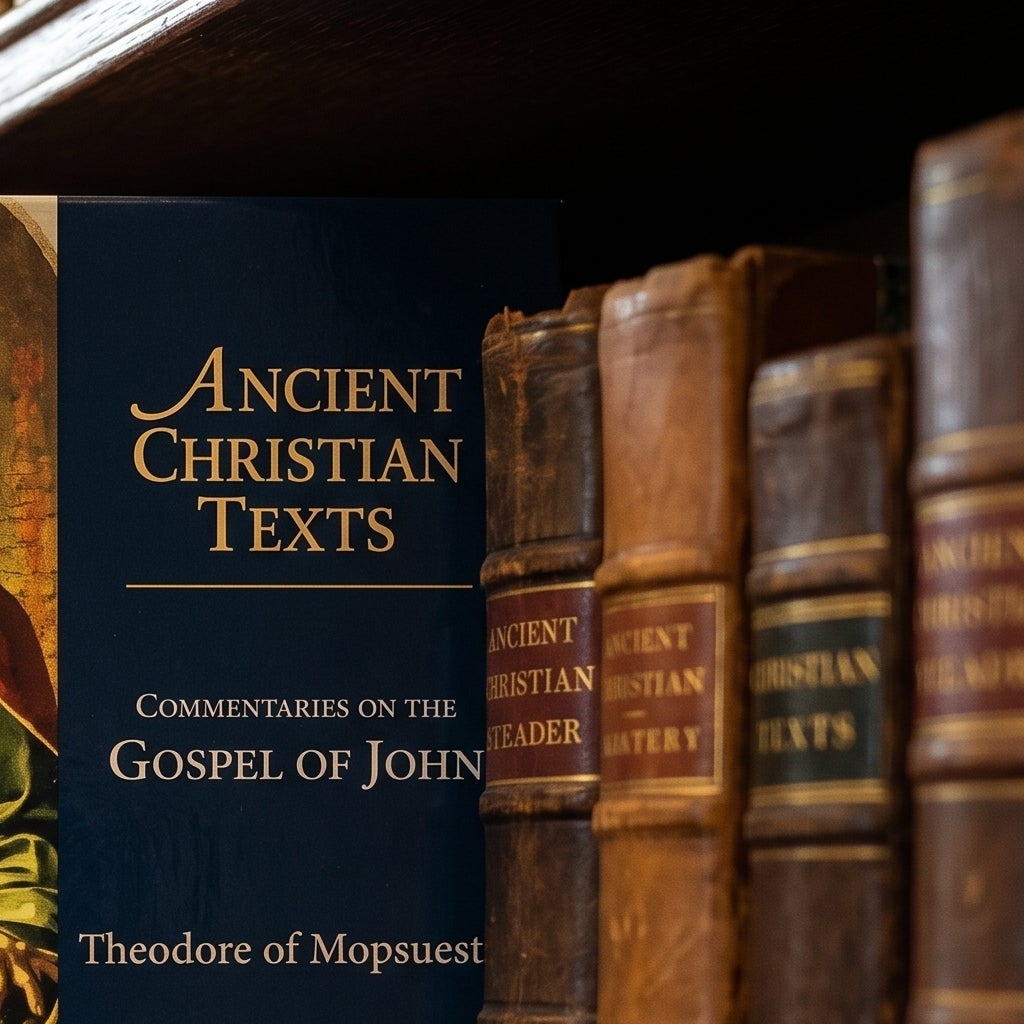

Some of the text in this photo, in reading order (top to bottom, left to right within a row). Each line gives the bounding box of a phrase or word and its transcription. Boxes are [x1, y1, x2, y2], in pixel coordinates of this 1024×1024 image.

[130, 346, 462, 421] ANCIENT
[133, 426, 463, 483] CHRISTIAN
[197, 495, 395, 553] TEXTS
[489, 616, 578, 653] ANCIENT
[487, 665, 595, 700] CHRISTIAN
[135, 693, 457, 718] COMMENTARIES ON THE
[109, 739, 484, 791] GOSPEL OF JOHN
[78, 931, 252, 965] Theodore
[263, 930, 303, 965] of
